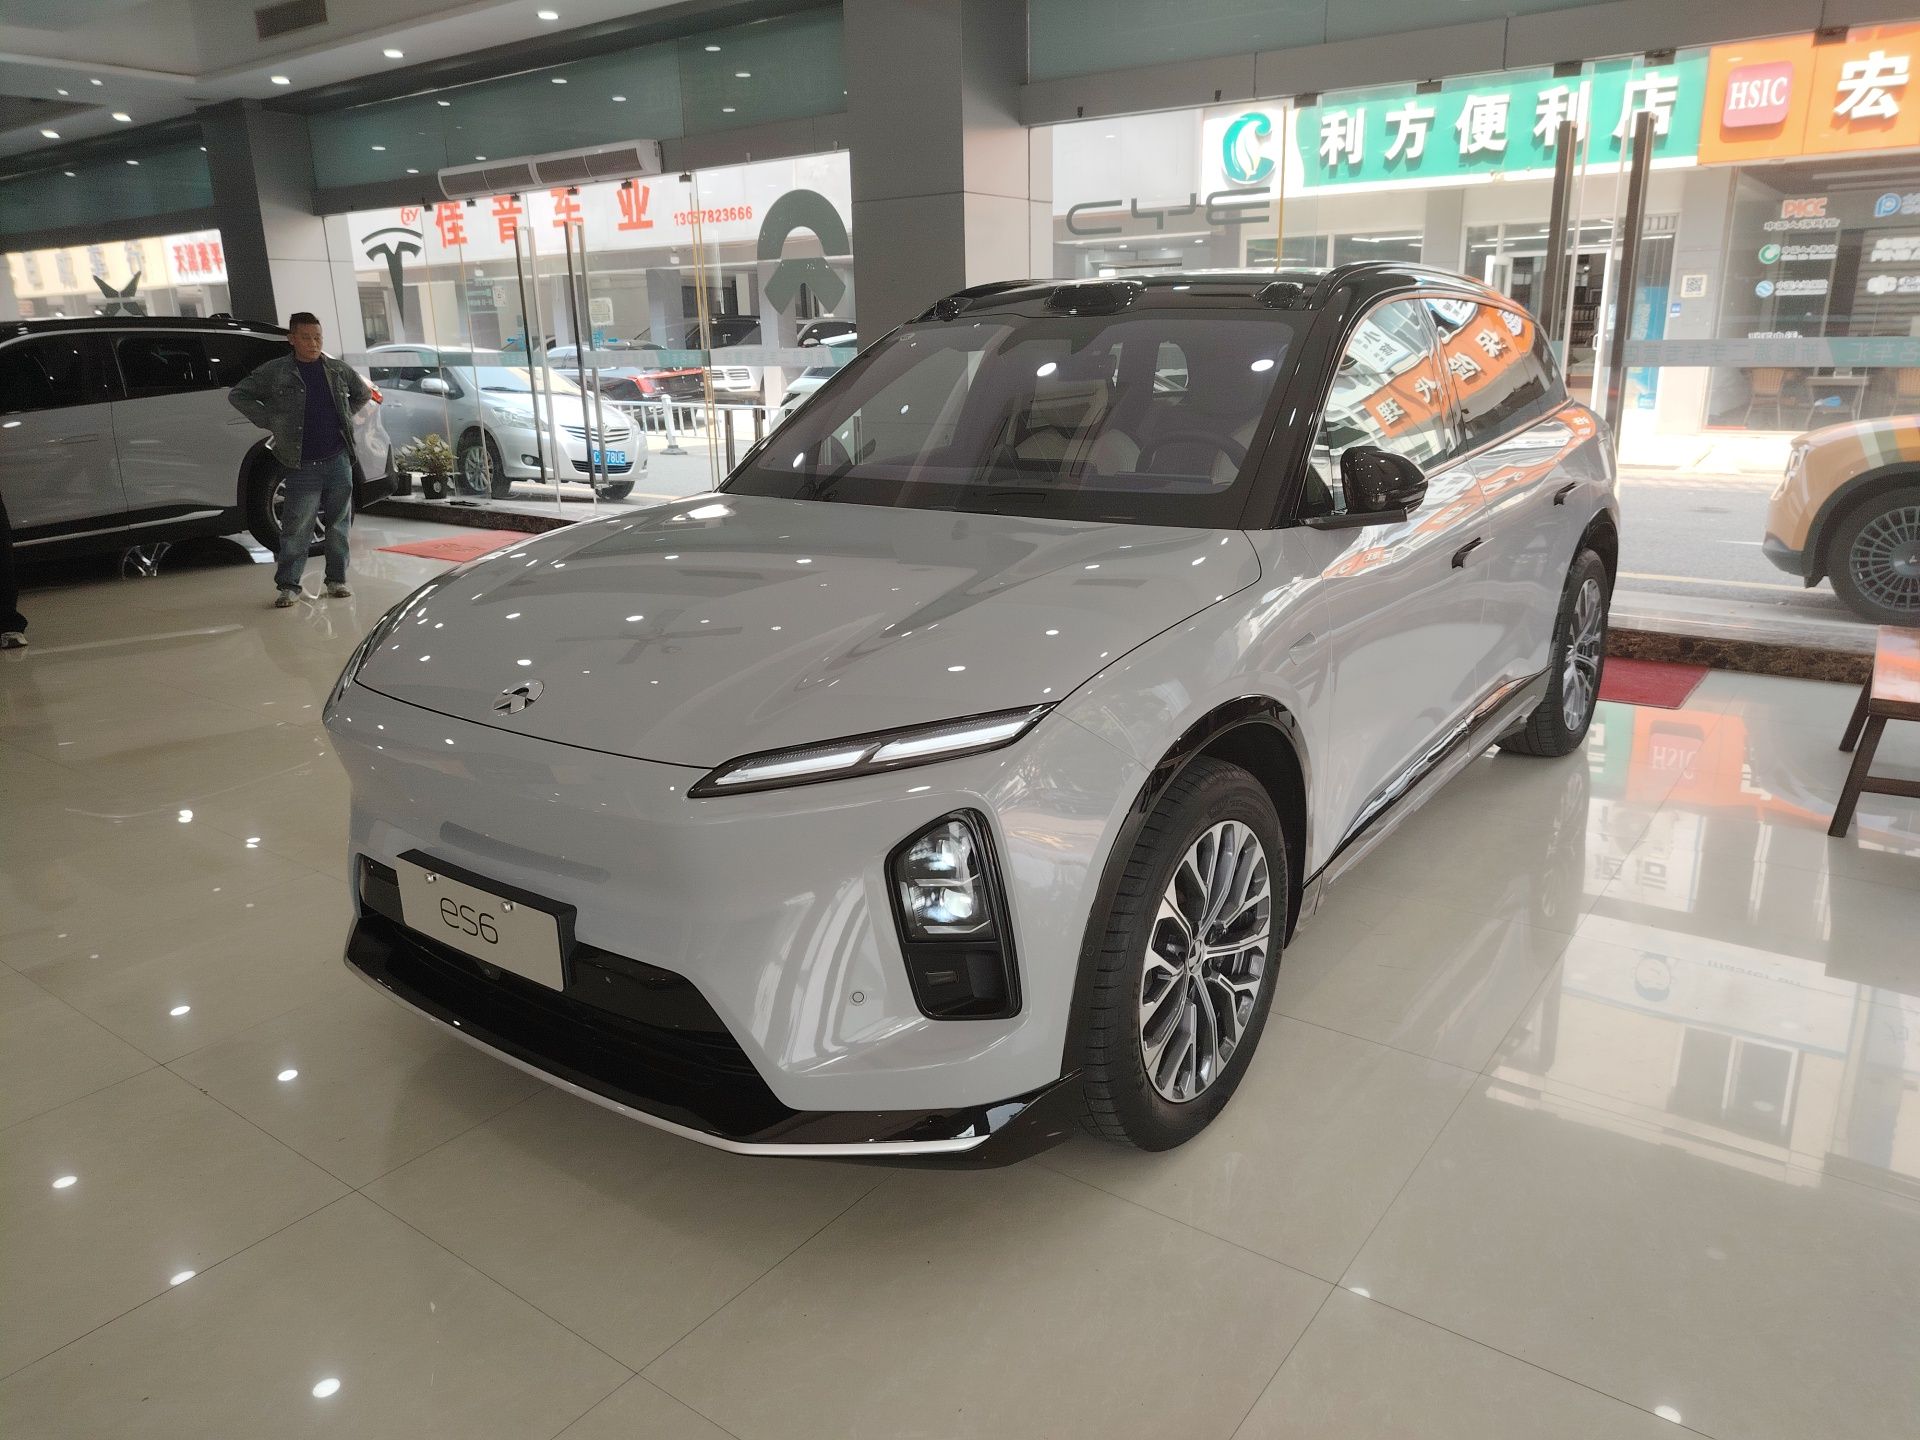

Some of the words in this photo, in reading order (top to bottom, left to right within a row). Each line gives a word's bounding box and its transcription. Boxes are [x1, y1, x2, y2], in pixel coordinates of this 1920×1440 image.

[1319, 71, 1679, 166] 利方便利店
[1728, 76, 1788, 110] HSIC
[1833, 50, 1910, 119] 宏
[435, 179, 654, 249] 佳音车业
[1781, 198, 1828, 219] PICC
